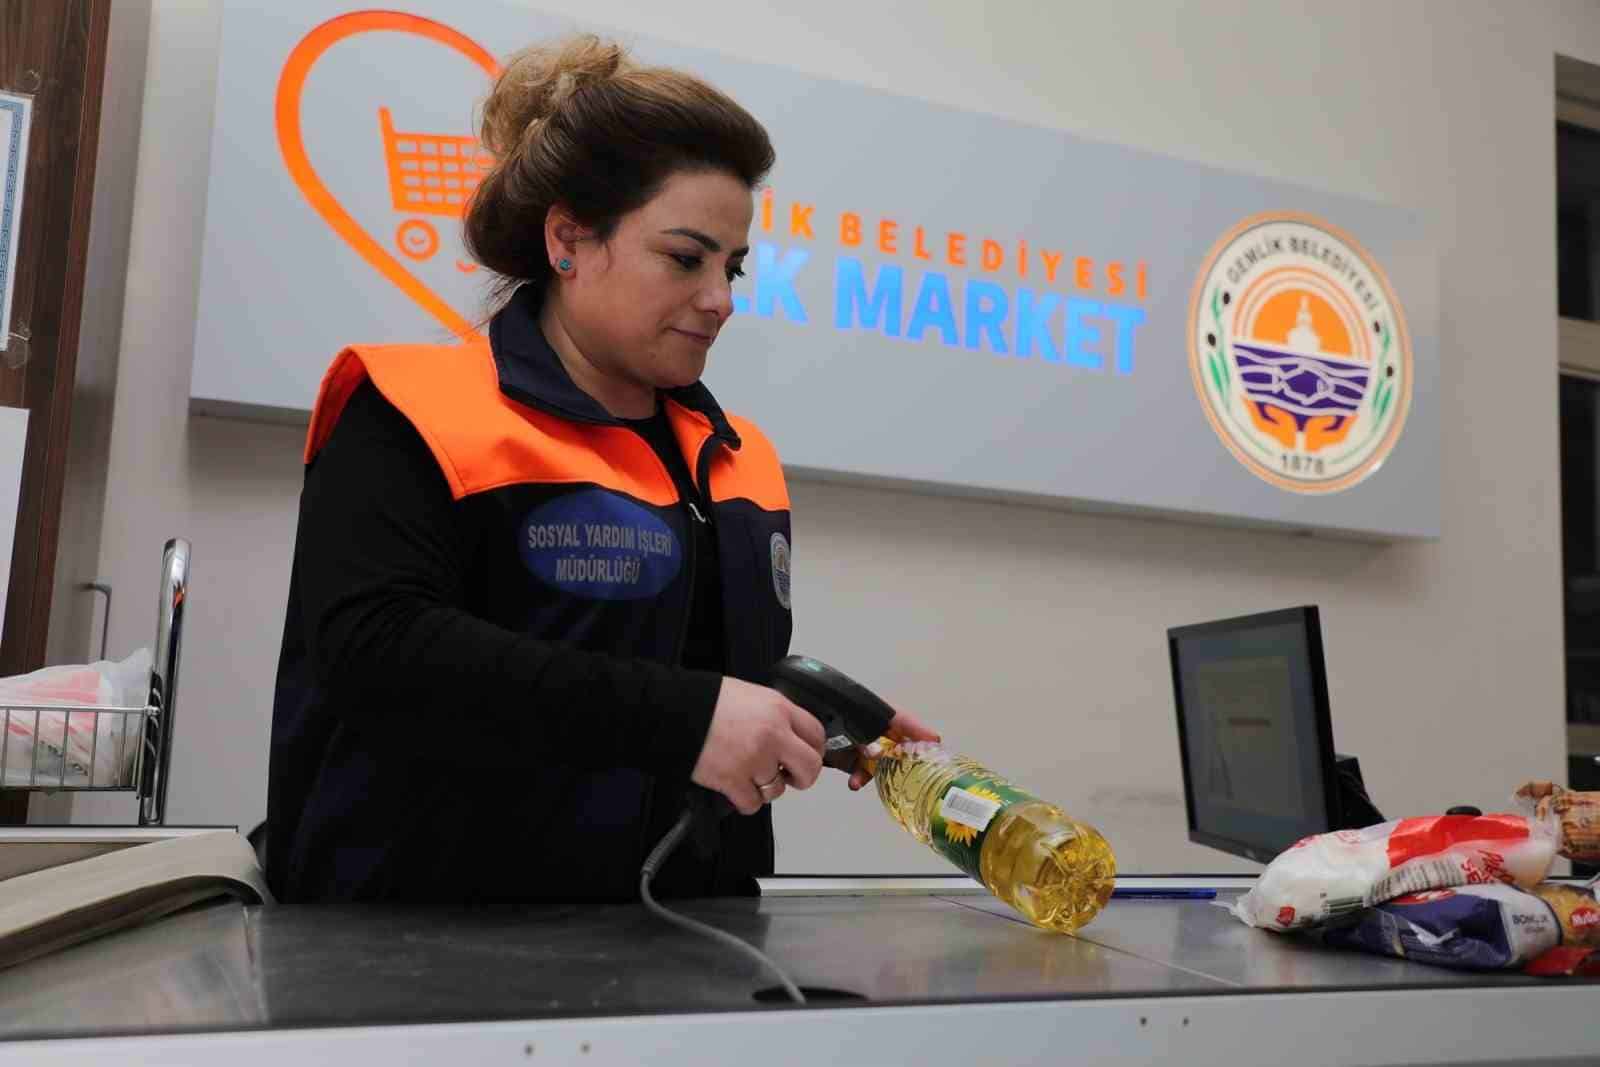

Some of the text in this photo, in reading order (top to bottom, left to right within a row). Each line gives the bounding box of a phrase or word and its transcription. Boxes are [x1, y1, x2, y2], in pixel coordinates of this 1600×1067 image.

[838, 210, 1149, 300] BELEDİYESİ
[833, 255, 1147, 376] MARKET
[527, 523, 673, 558] SOSYAL YARDIM İŞLERİ
[555, 554, 642, 585] MÜDÜRLÜĞÜ
